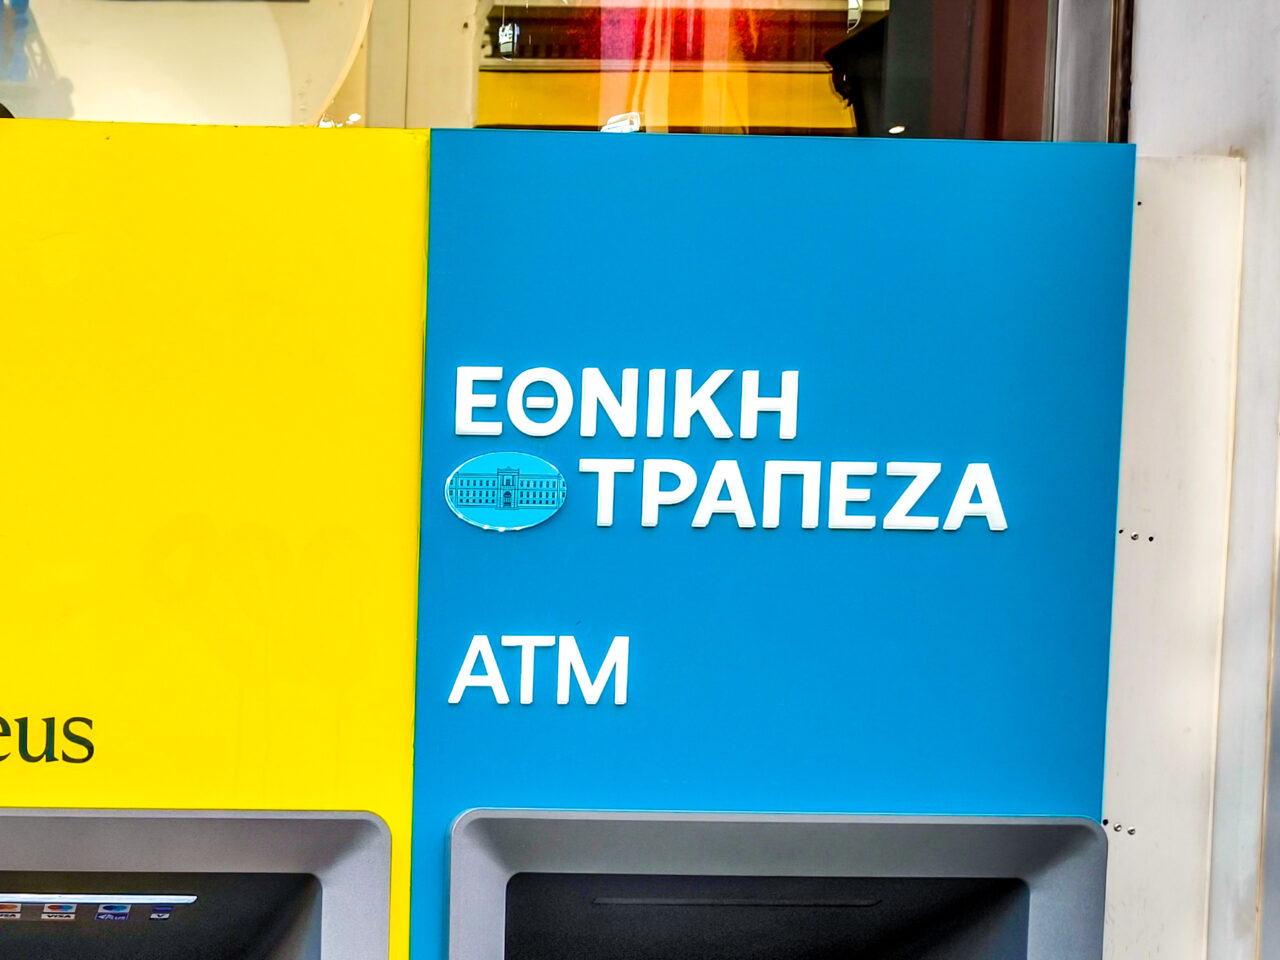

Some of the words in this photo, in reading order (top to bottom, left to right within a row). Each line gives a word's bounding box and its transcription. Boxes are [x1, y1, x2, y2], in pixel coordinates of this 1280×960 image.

[455, 366, 799, 440] ΕΘΝΙΚΗ
[578, 458, 1009, 532] ΤΡΑΠΕΖΑ
[447, 634, 630, 705] ATM
